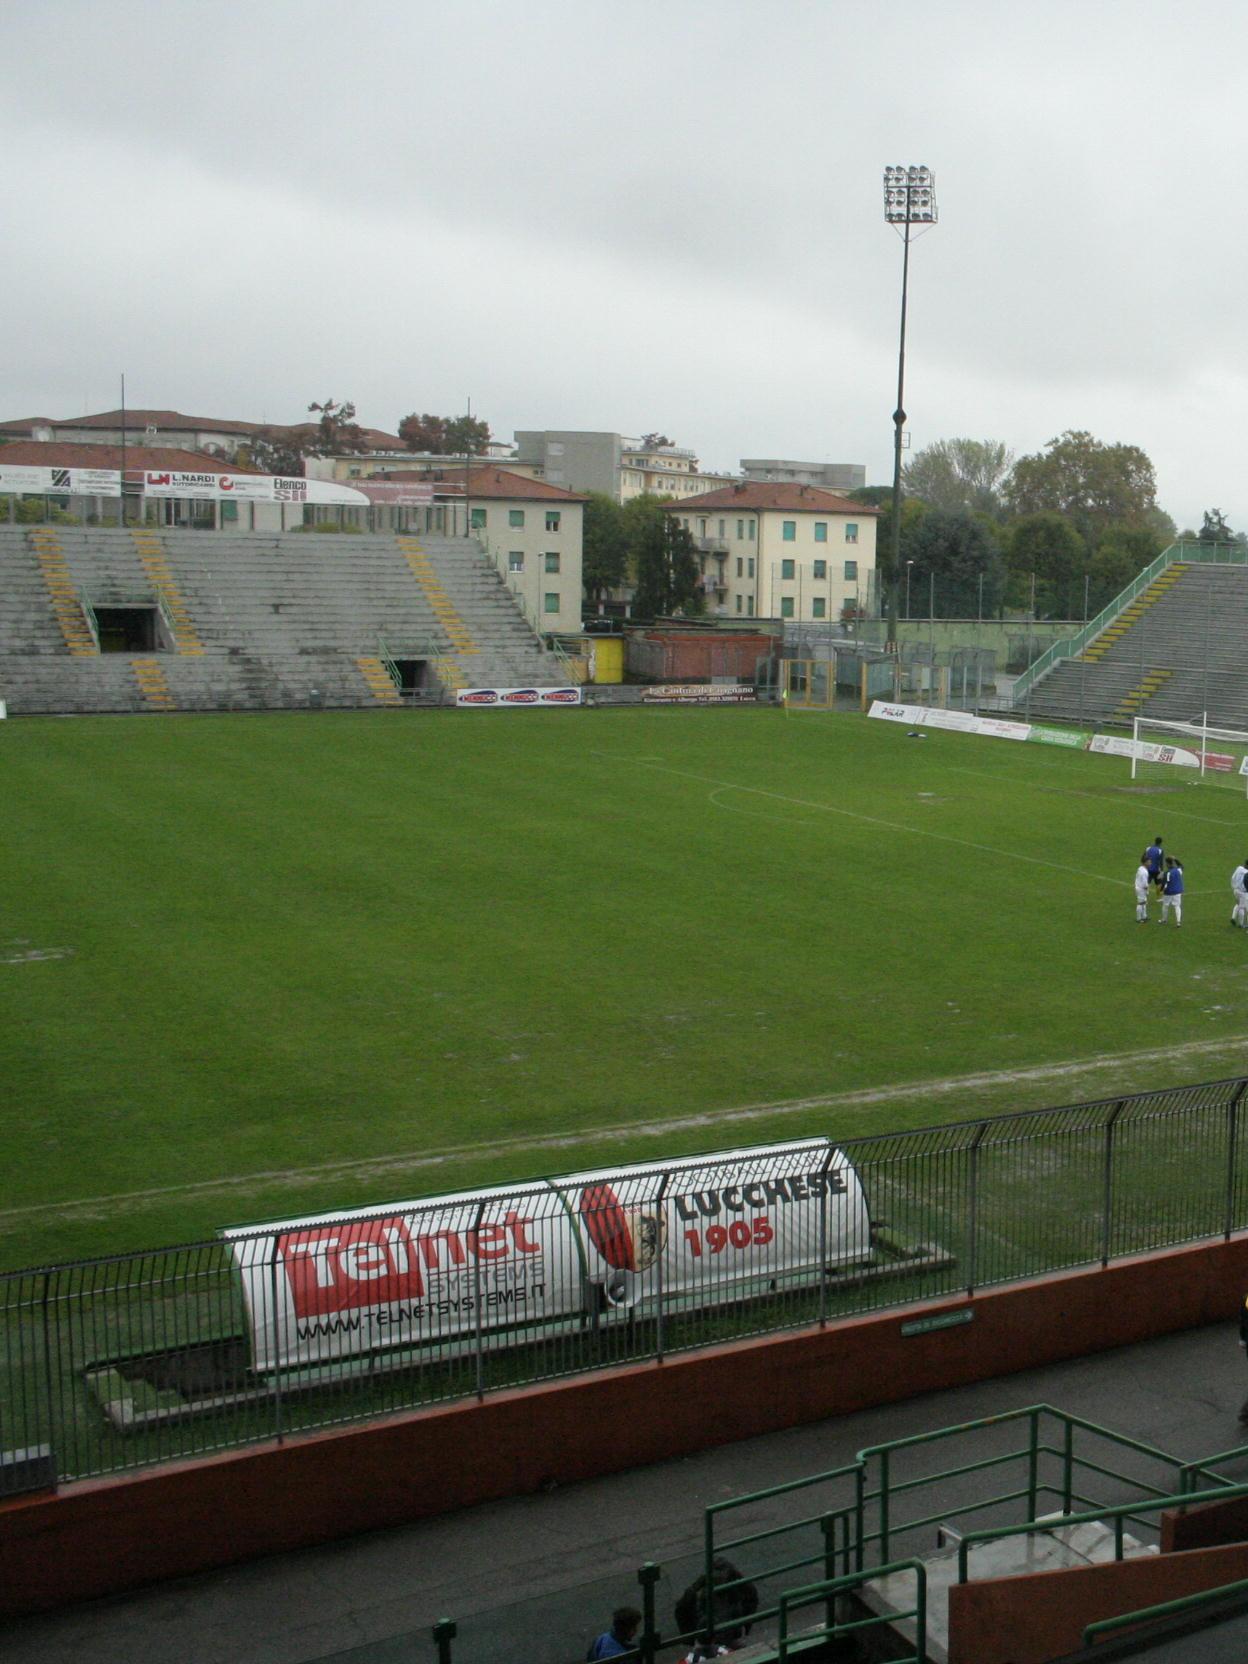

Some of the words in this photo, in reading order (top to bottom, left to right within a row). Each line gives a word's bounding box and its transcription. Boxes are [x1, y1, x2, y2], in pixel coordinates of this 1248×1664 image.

[274, 478, 307, 490] Elenco
[674, 1169, 848, 1222] LUCCHESE
[290, 1211, 540, 1288] Telnet
[684, 1216, 774, 1257] 1905
[428, 1260, 545, 1295] SYSTEMS
[297, 1283, 546, 1340] WWW.TELNETSYSTEMS.IT
